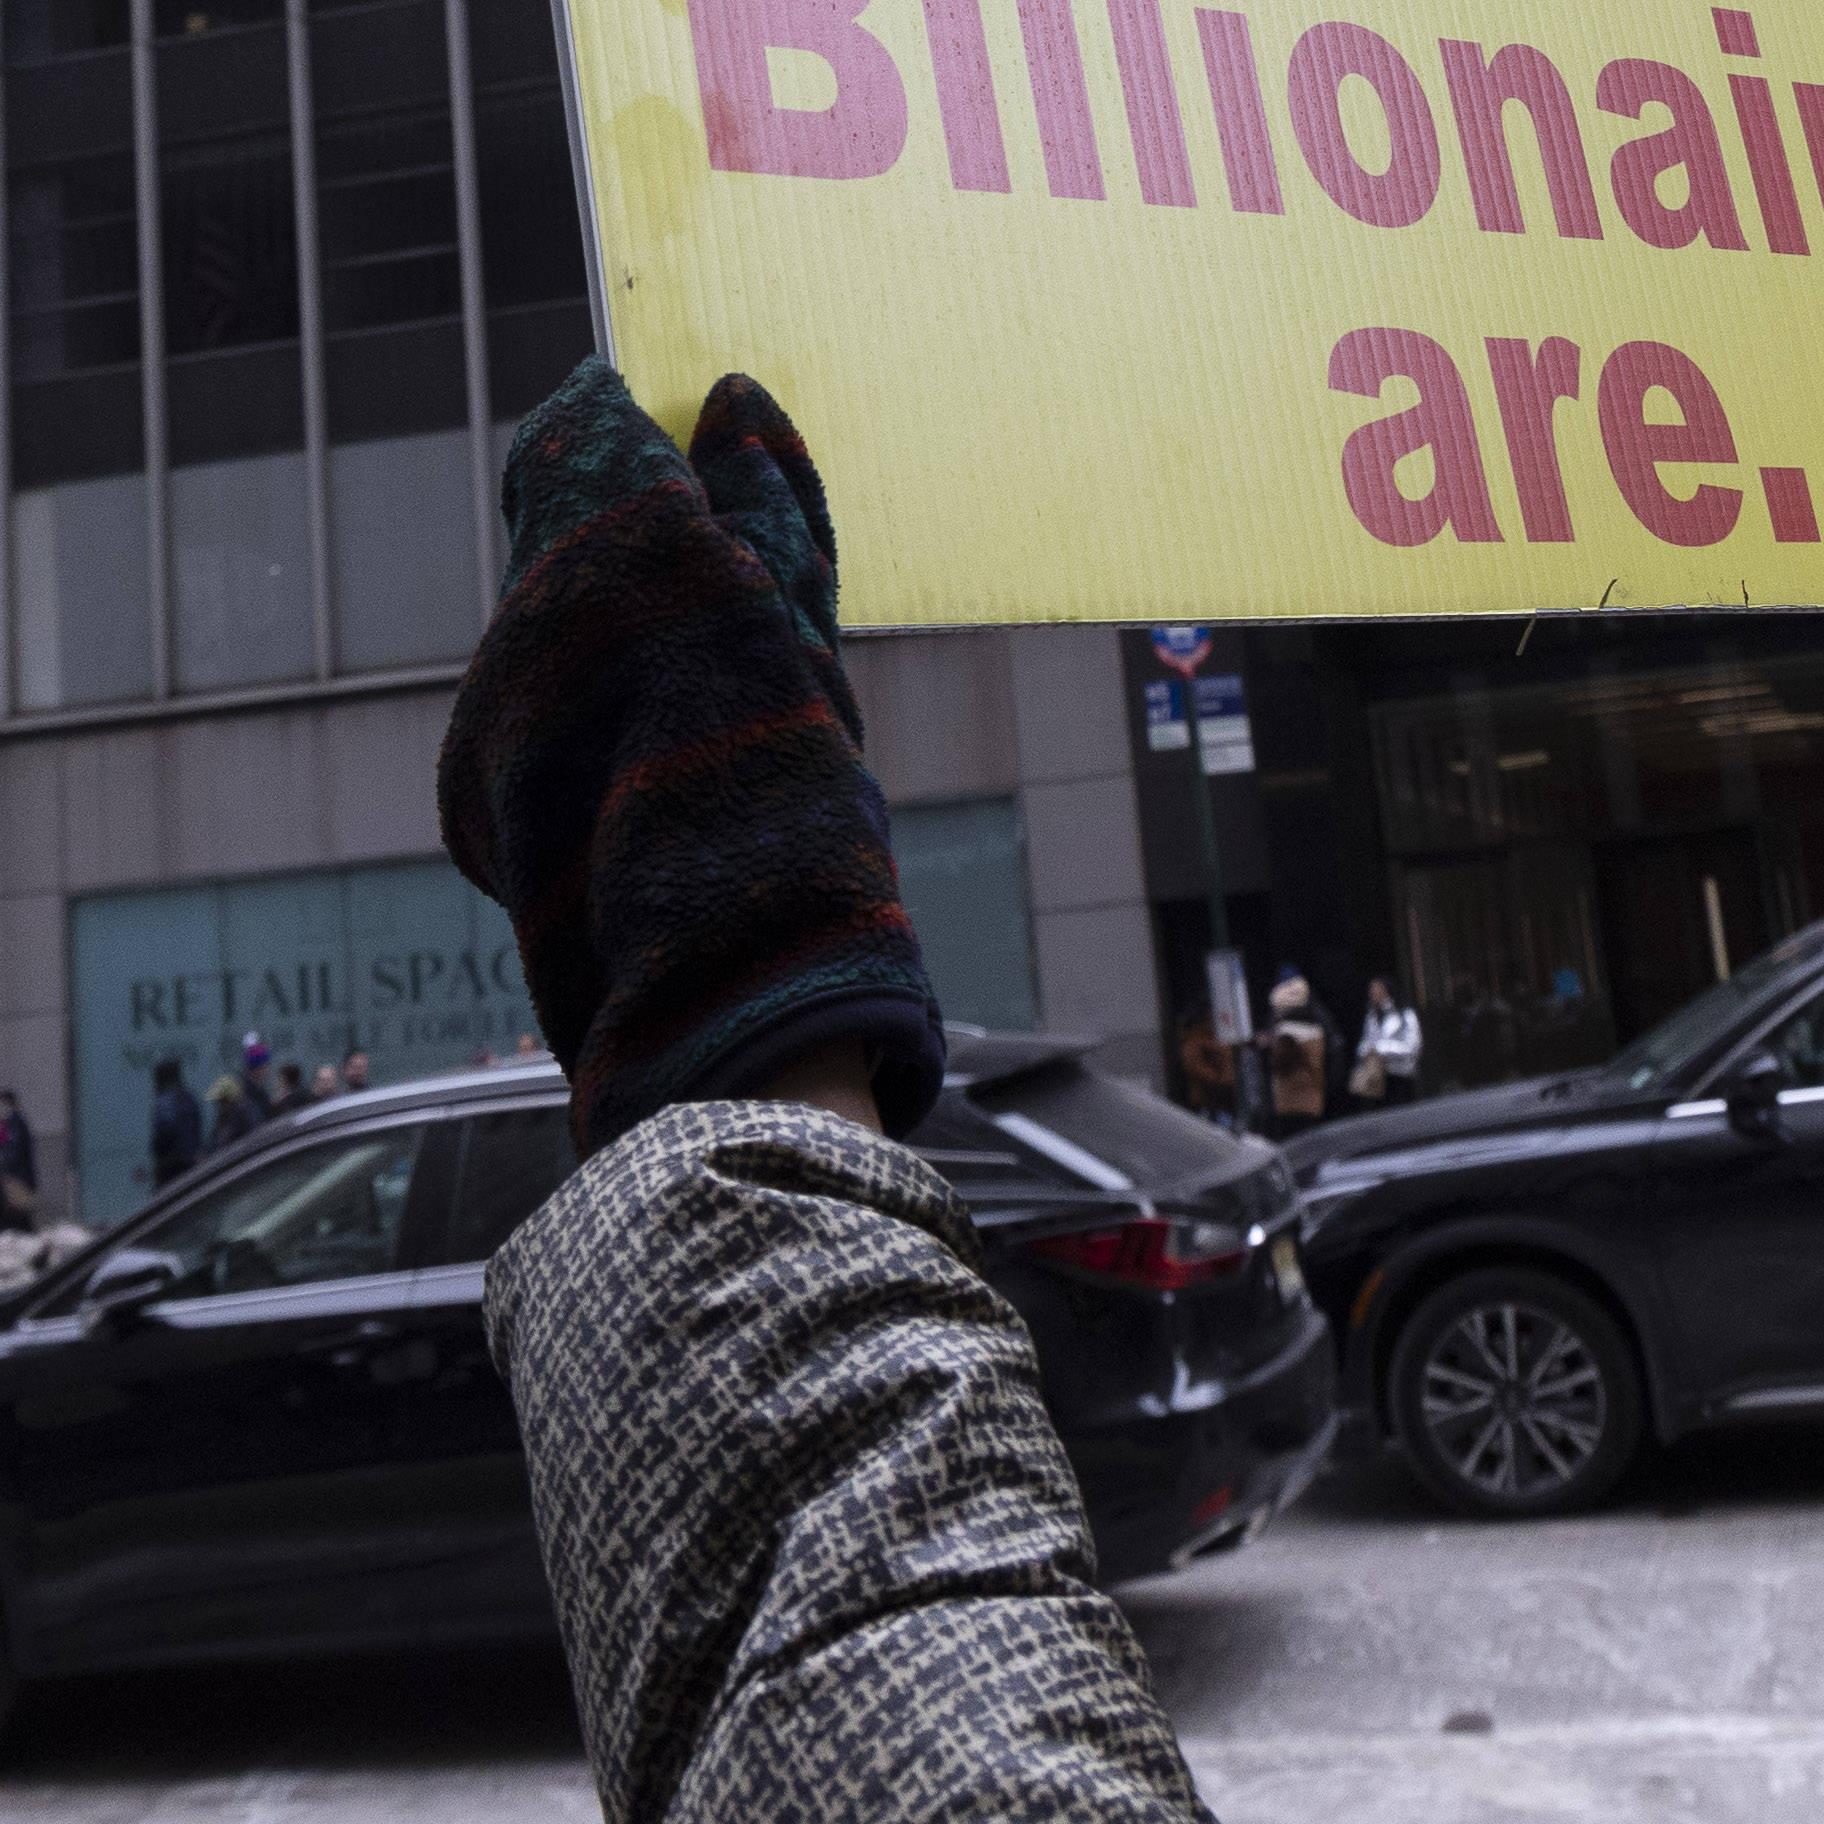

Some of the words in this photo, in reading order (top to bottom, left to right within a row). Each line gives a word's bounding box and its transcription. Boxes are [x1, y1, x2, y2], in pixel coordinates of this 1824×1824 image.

[1326, 325, 1821, 548] are.
[129, 960, 354, 1033] RETAIL
[370, 944, 523, 1010] SPAC
